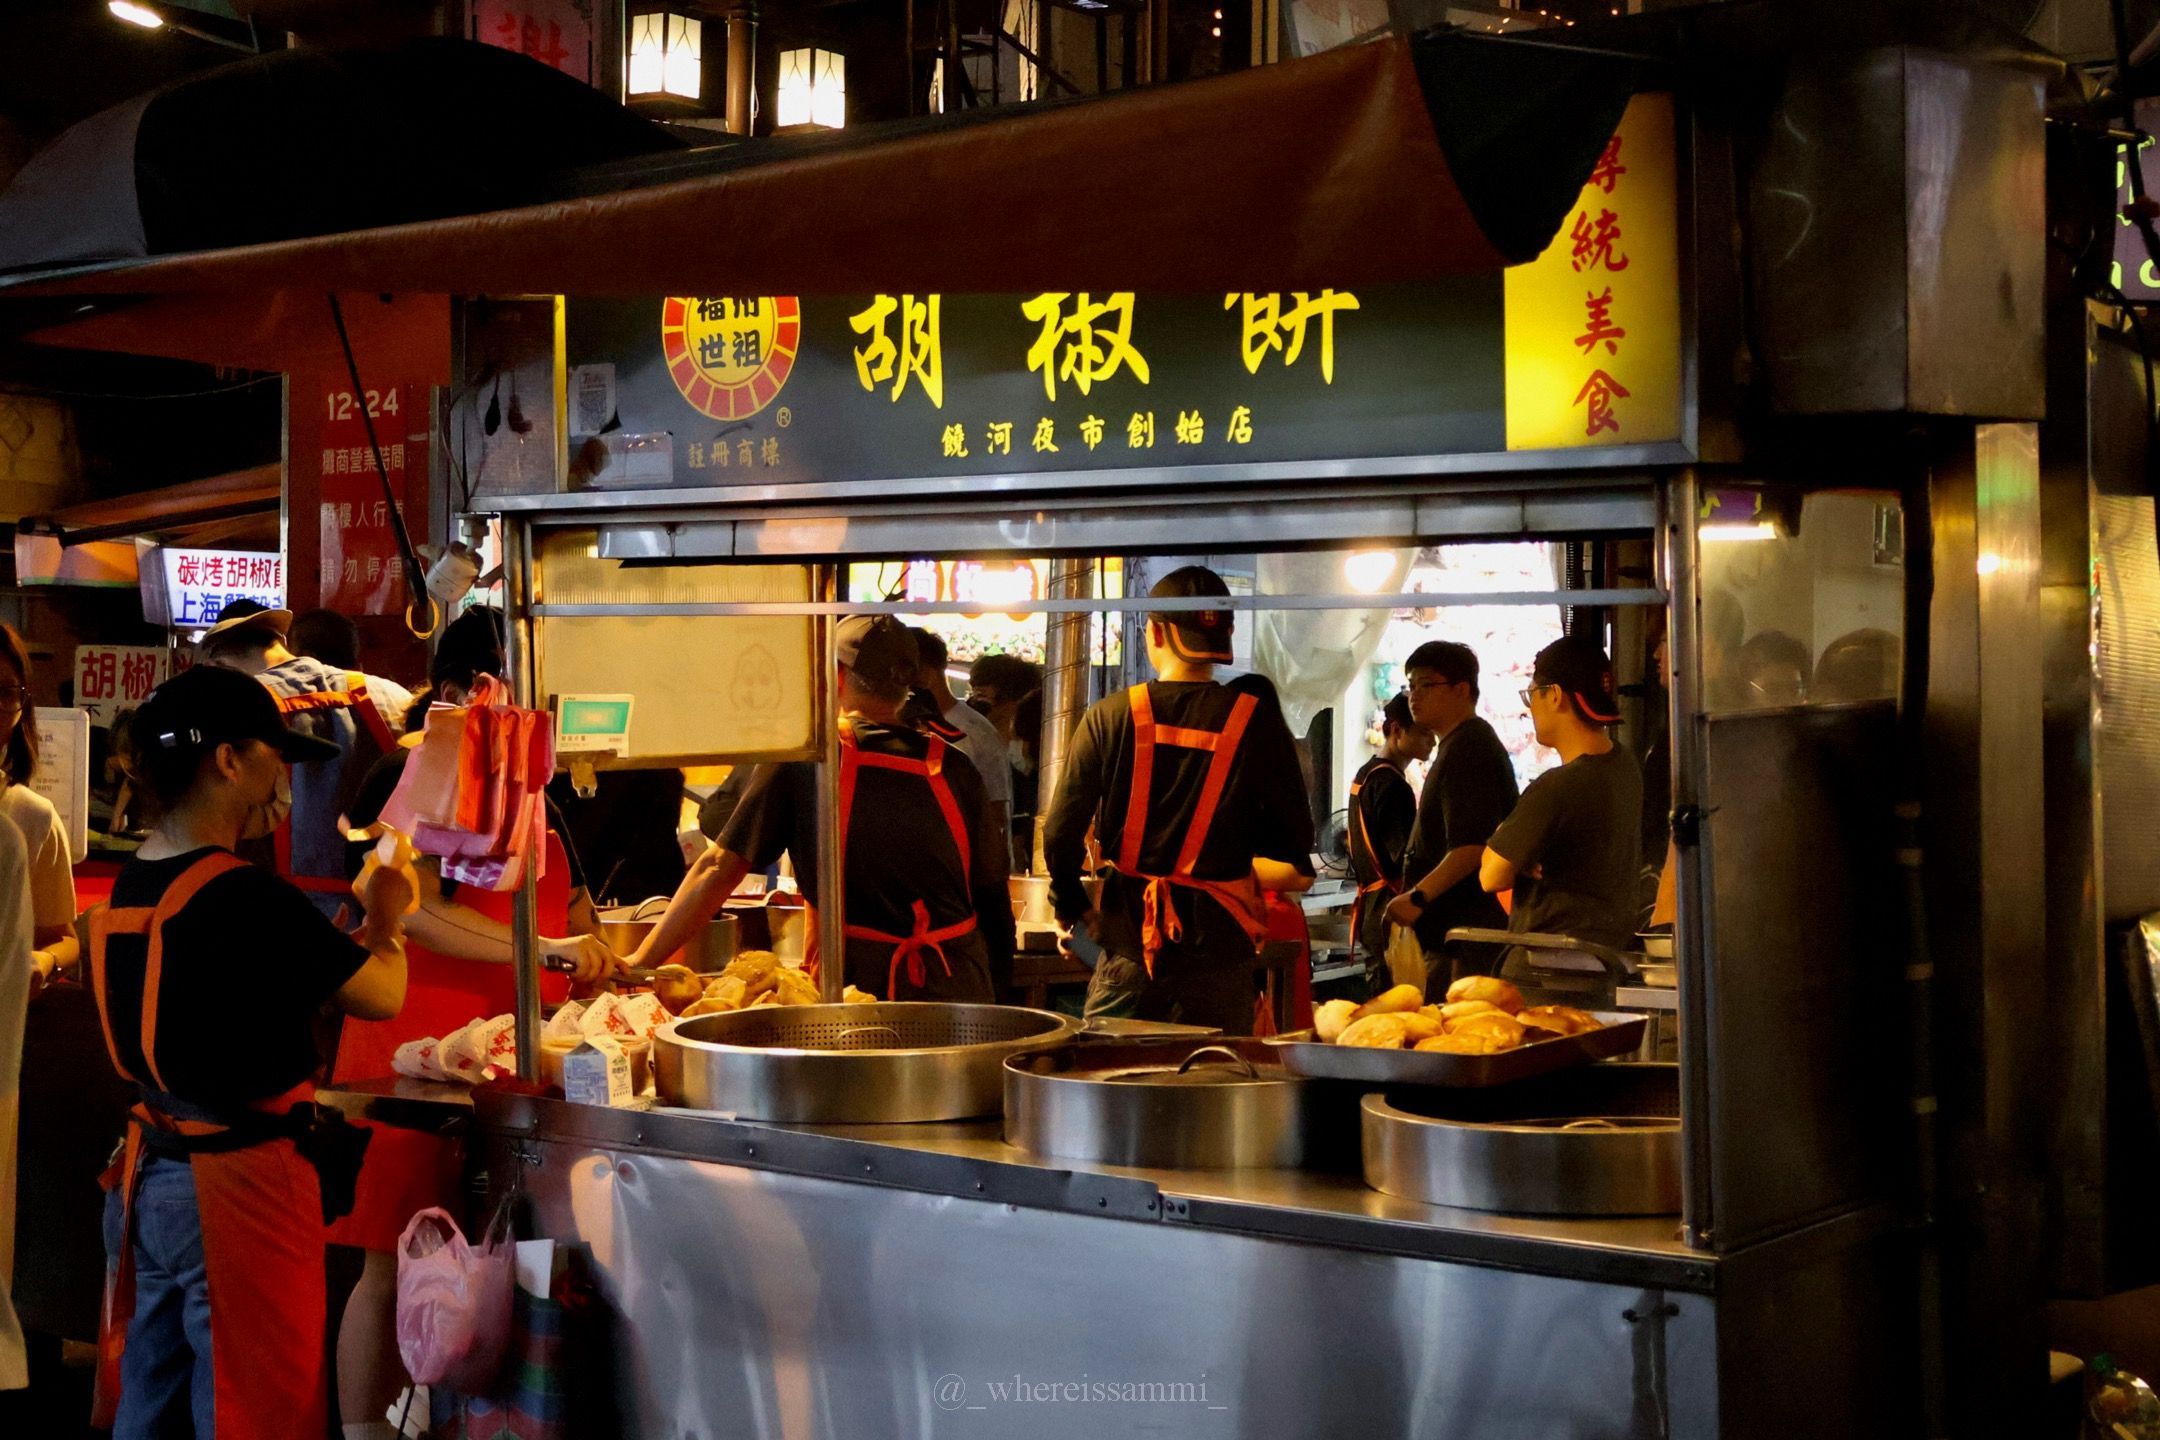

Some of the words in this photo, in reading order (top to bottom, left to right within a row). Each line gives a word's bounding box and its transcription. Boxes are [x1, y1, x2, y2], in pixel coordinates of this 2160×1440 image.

[698, 329, 764, 370] 世祖
[326, 387, 399, 422] 12-24
[940, 405, 1255, 458] 饒河夜市創始店
[687, 436, 782, 469] 註冊商標
[80, 650, 194, 700] 胡椒
